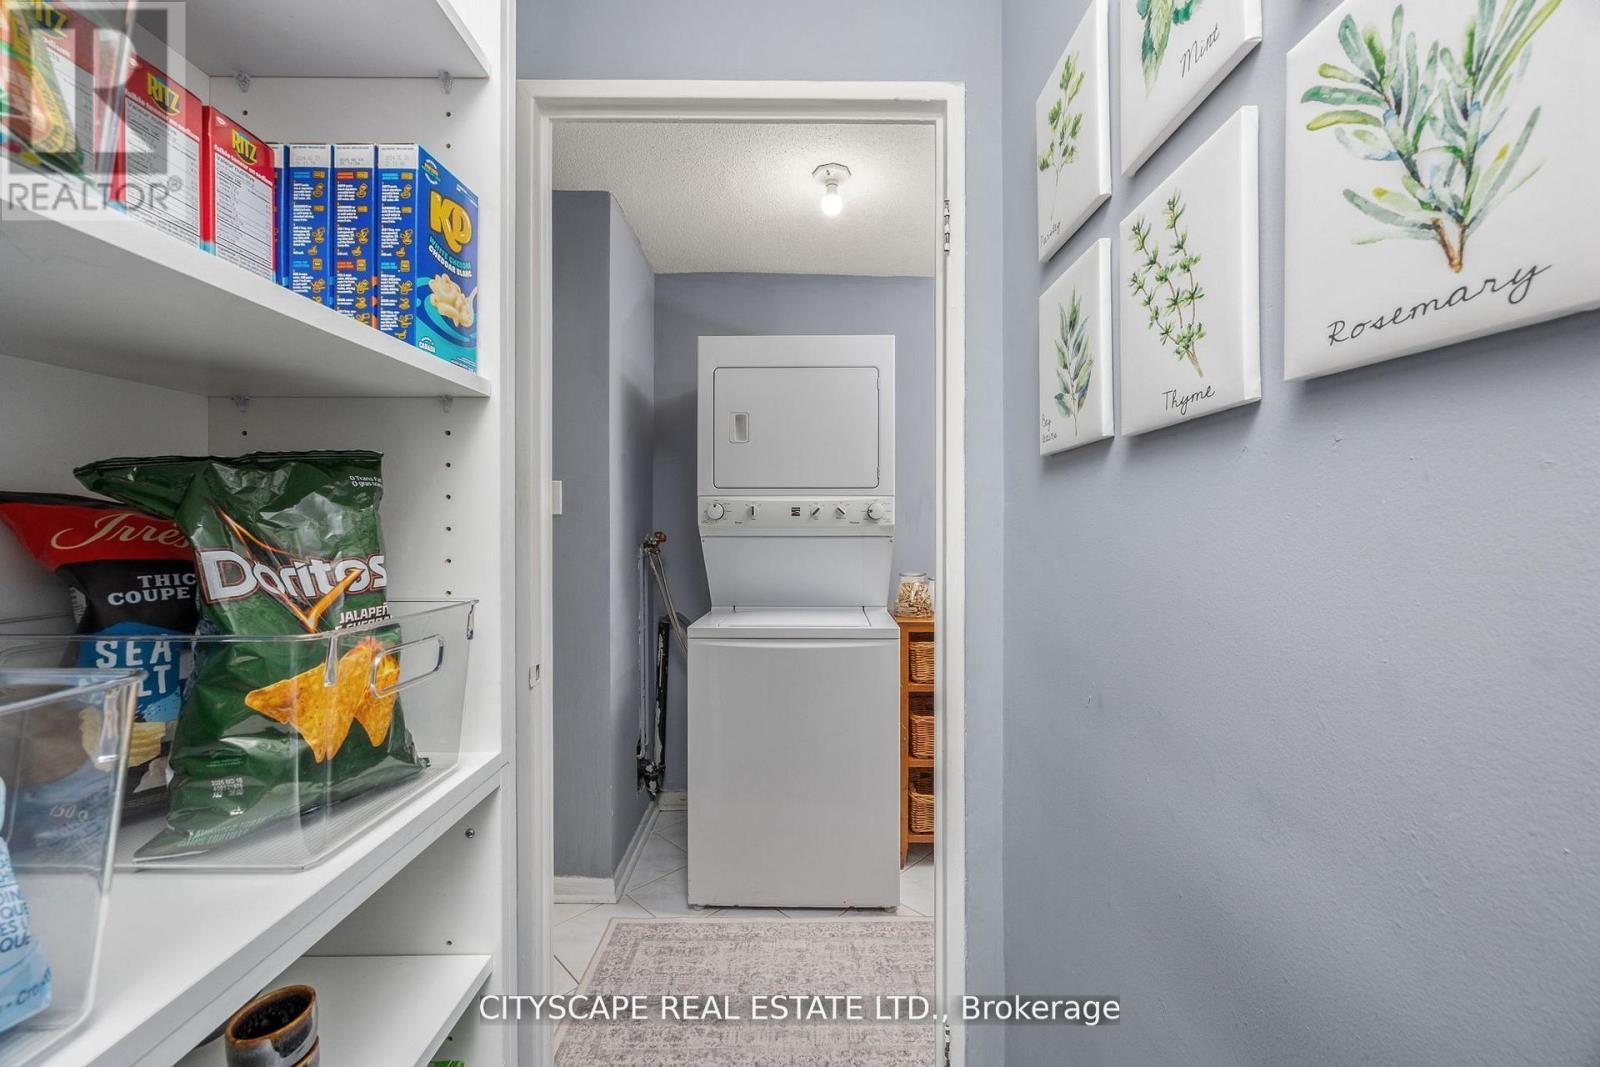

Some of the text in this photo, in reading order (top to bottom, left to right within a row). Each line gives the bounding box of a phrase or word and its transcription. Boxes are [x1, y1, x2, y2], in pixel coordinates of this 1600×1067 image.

[1180, 22, 1220, 78] Mint
[147, 72, 181, 115] RITZ
[231, 127, 258, 164] RITZ
[429, 189, 472, 254] KD
[428, 244, 457, 274] CHEDDAR
[1327, 264, 1552, 347] Rosemary
[1161, 385, 1216, 416] Thyme
[200, 549, 387, 600] Doritos
[107, 586, 190, 605] COUPE
[95, 633, 171, 668] SEA
